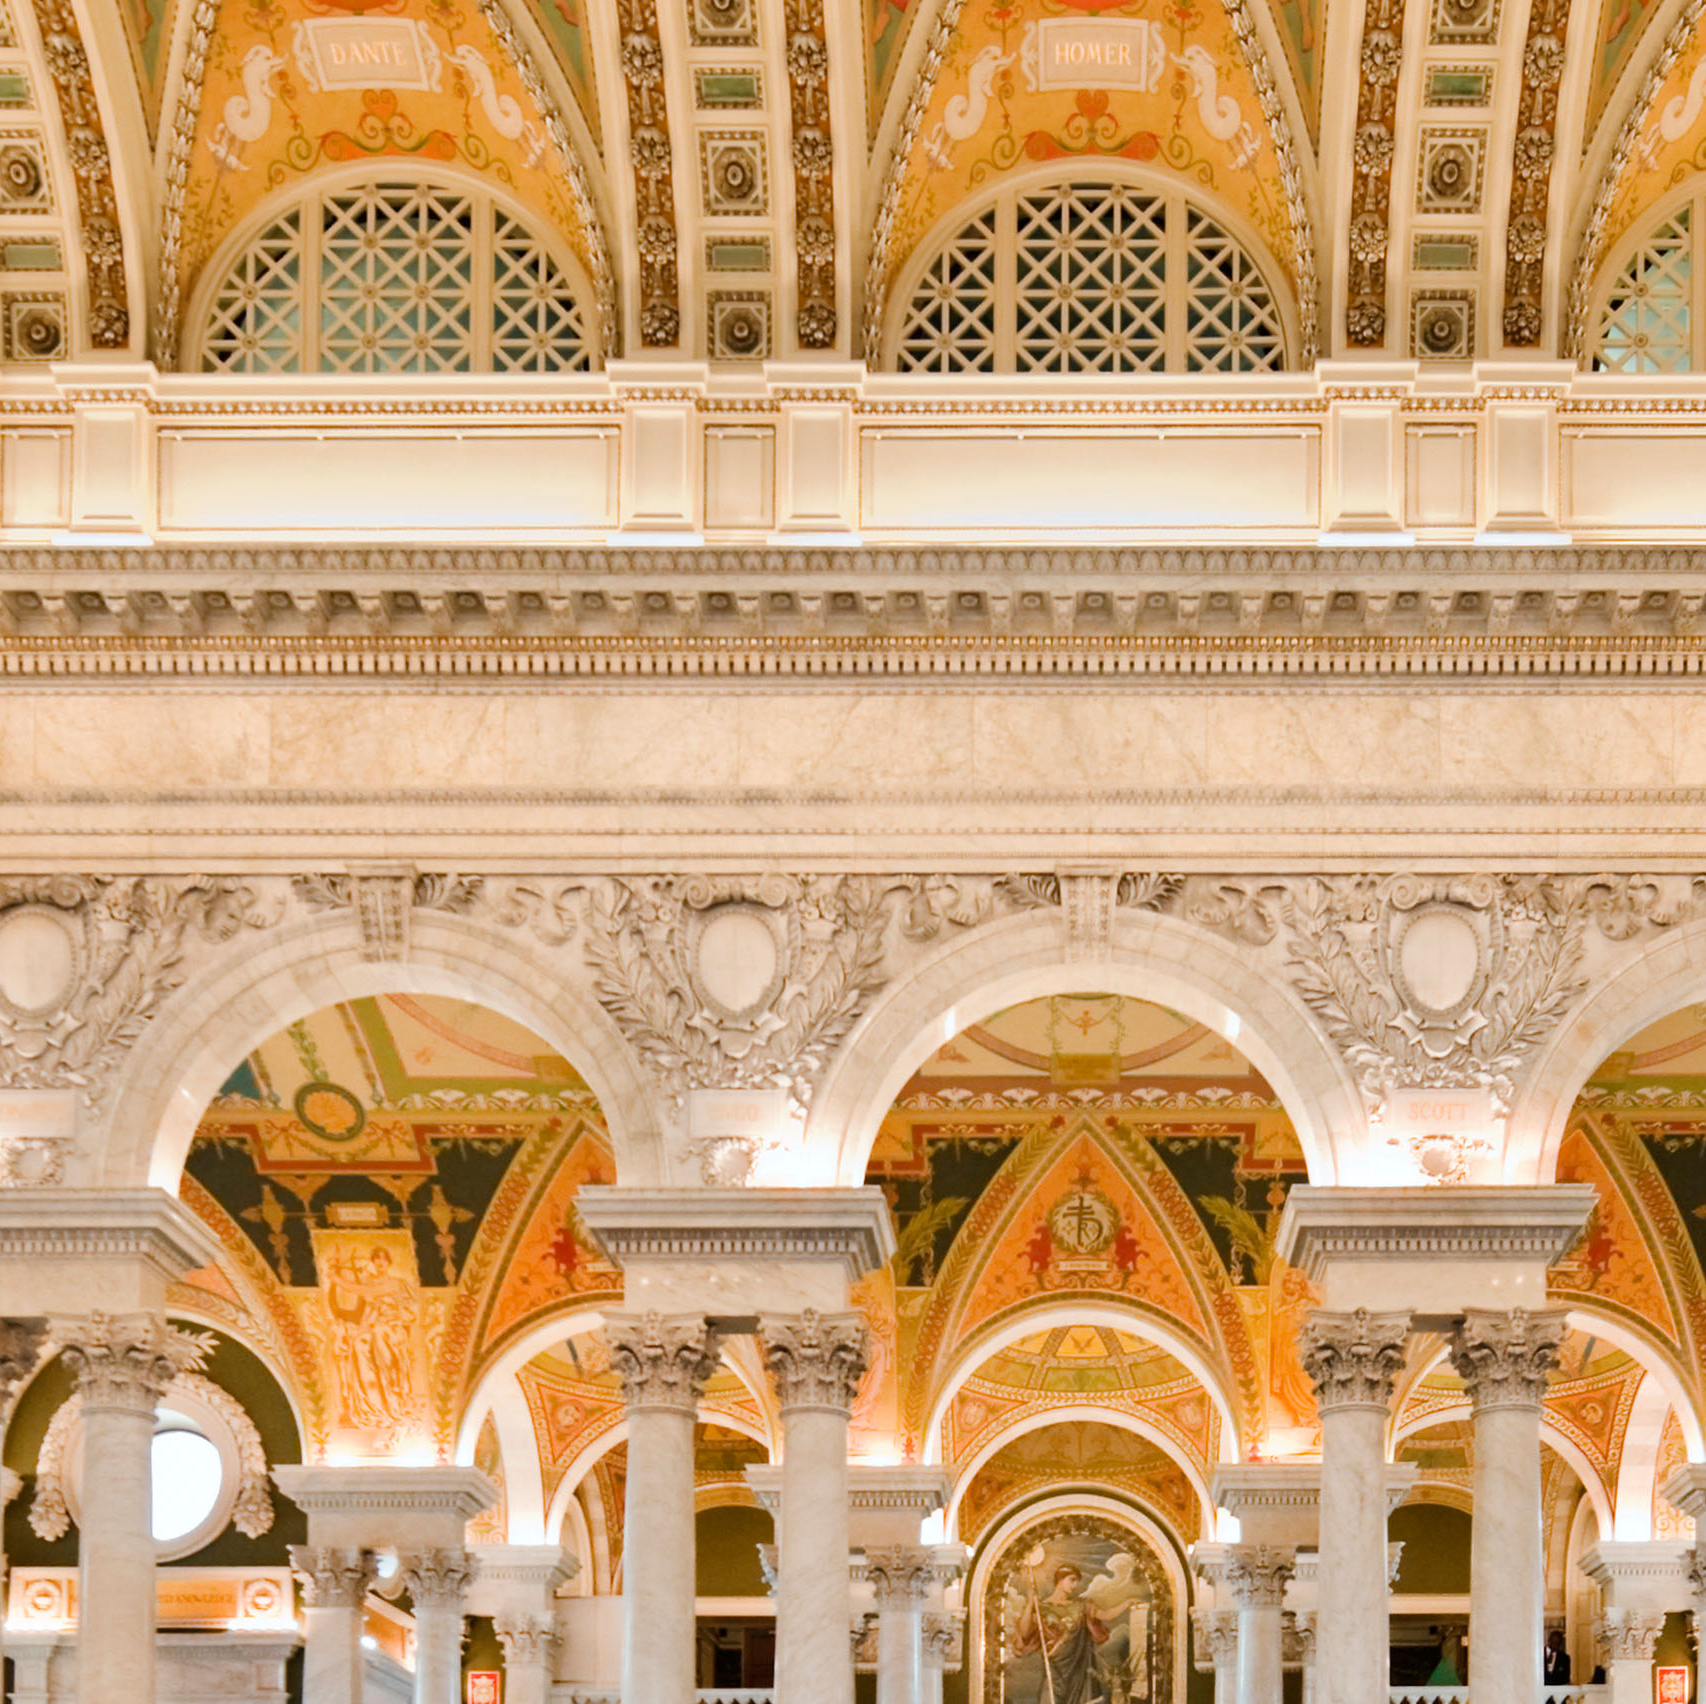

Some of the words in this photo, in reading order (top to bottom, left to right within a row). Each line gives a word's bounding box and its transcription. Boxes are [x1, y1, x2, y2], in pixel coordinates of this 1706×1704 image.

[329, 41, 407, 66] DANTE
[1054, 41, 1133, 66] HOMER
[1408, 1102, 1470, 1121] SCOTT
